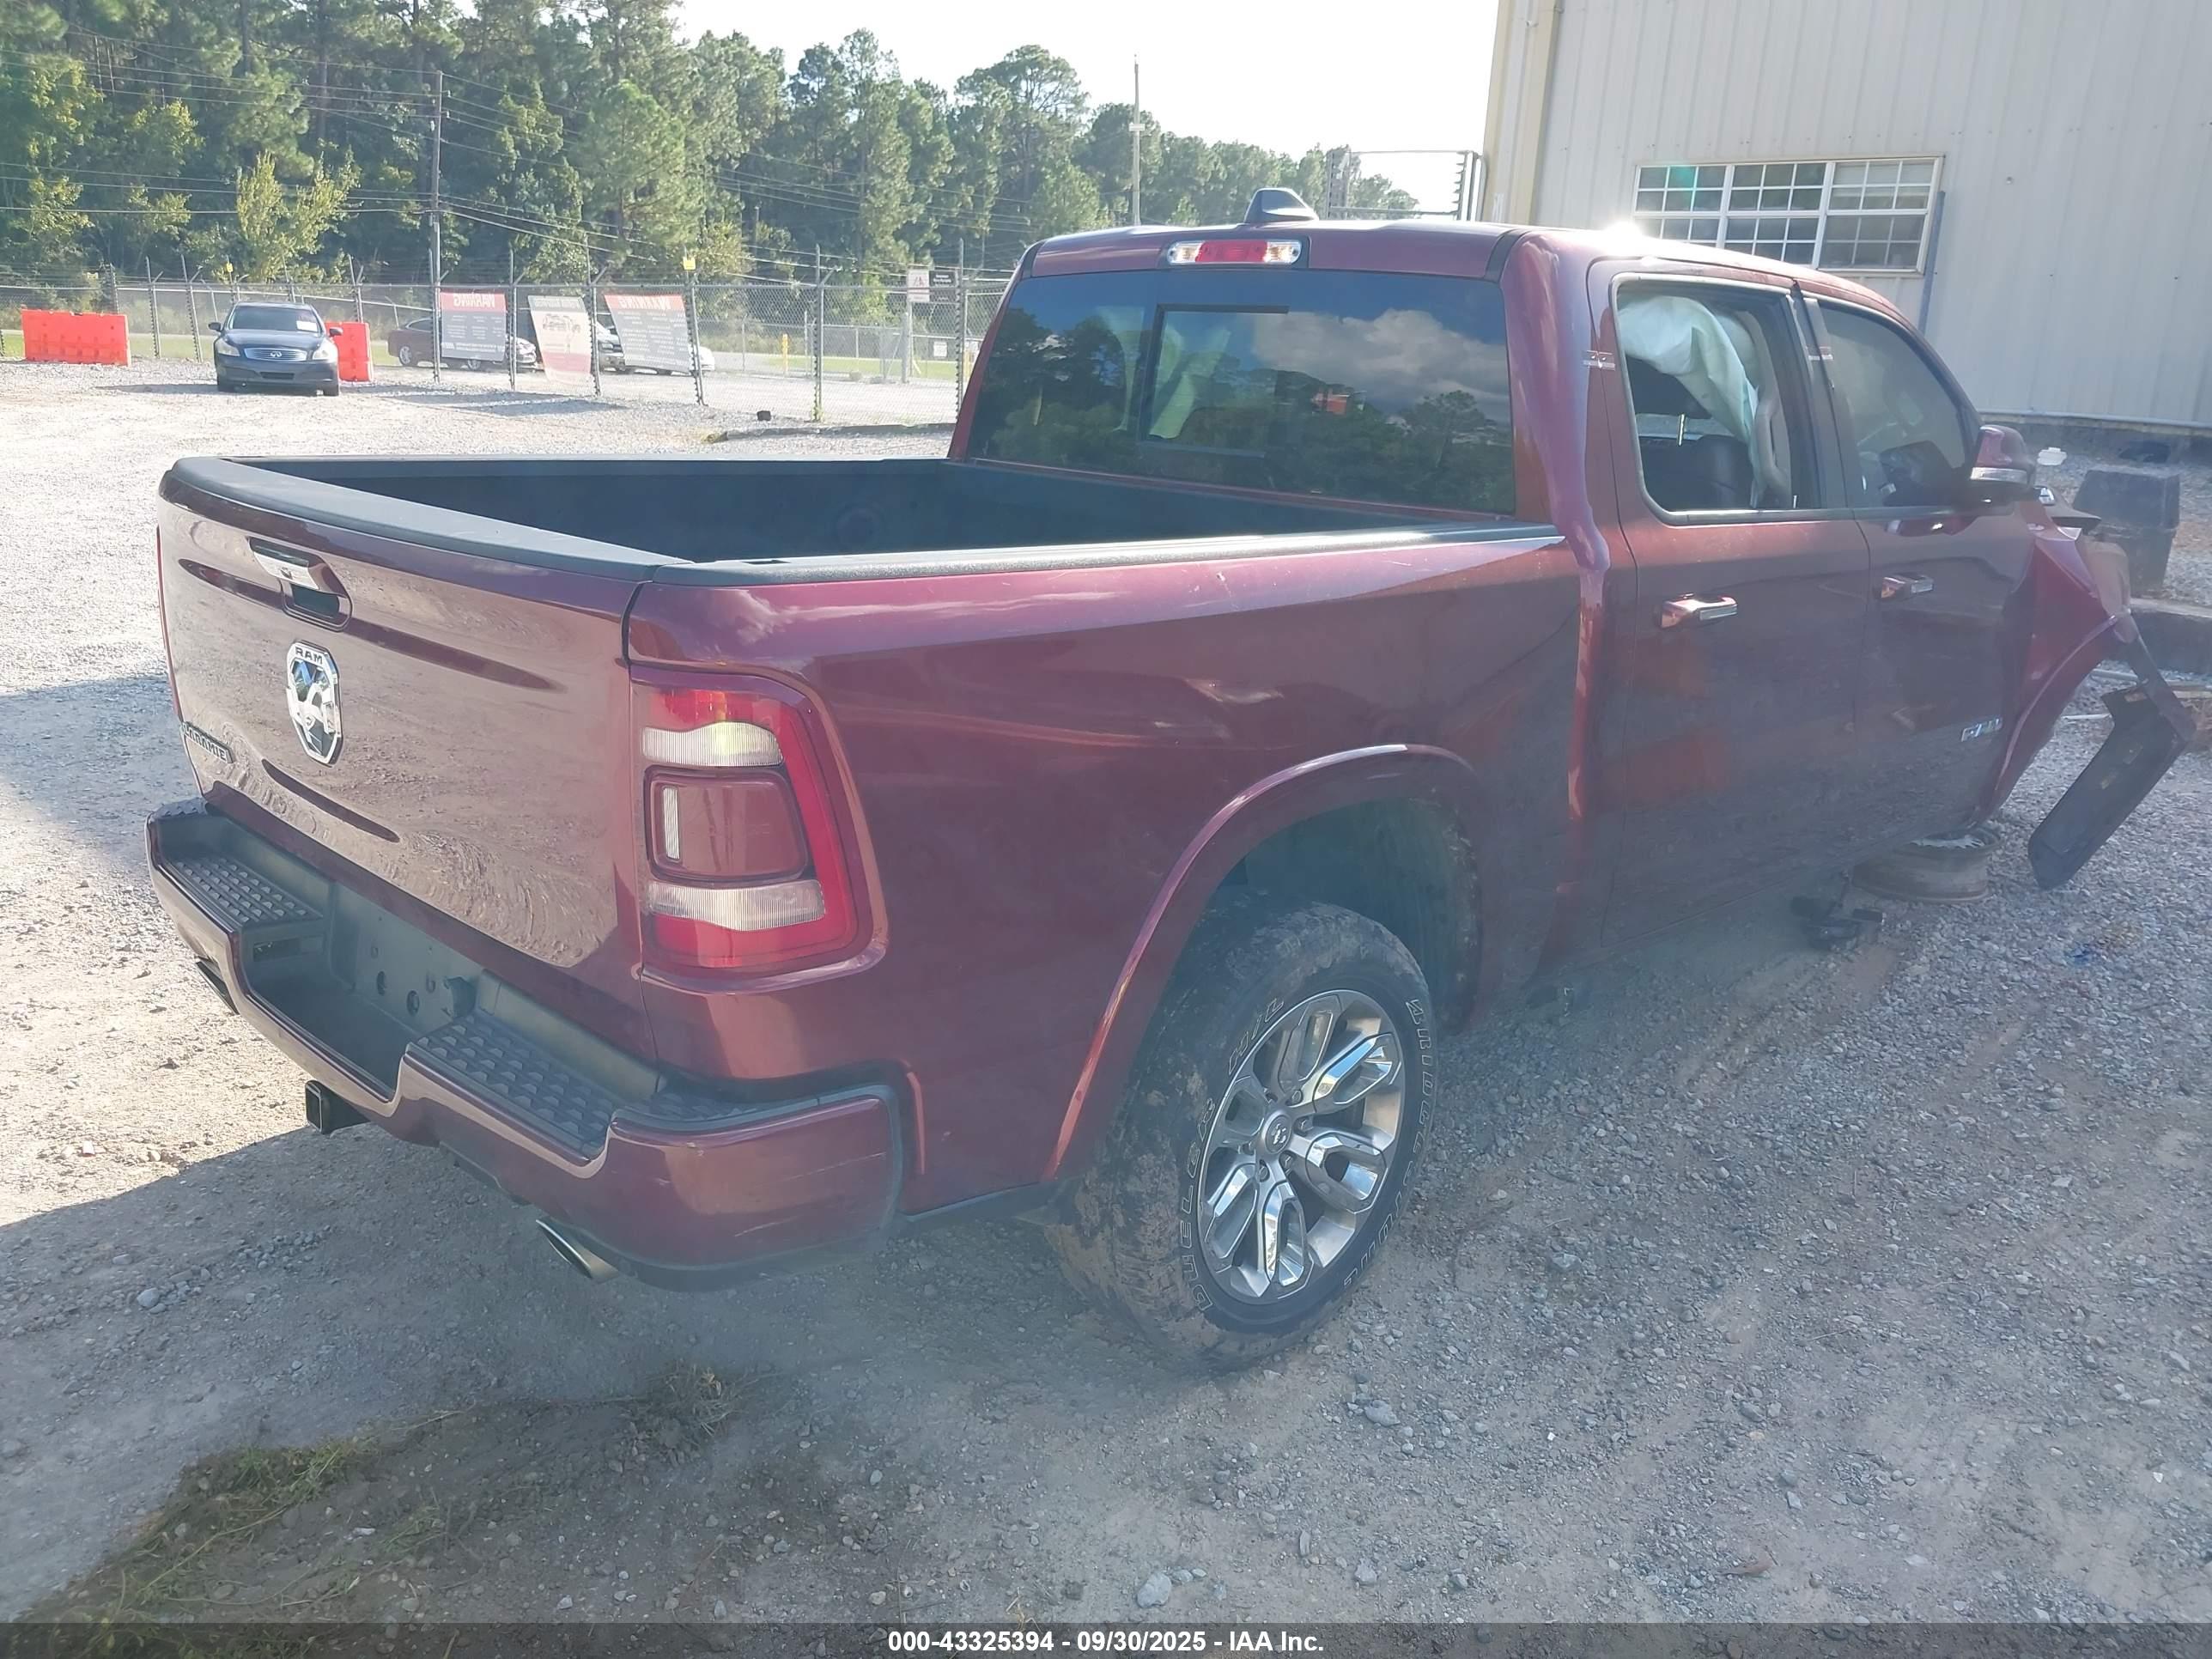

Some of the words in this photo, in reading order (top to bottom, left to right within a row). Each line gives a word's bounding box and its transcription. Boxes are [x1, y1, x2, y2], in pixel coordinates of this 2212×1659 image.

[295, 646, 323, 665] RAM
[182, 723, 227, 763] LARAMIE
[1179, 1097, 1216, 1312] DUELER
[1340, 998, 1433, 1286] BRIDGESTONE
